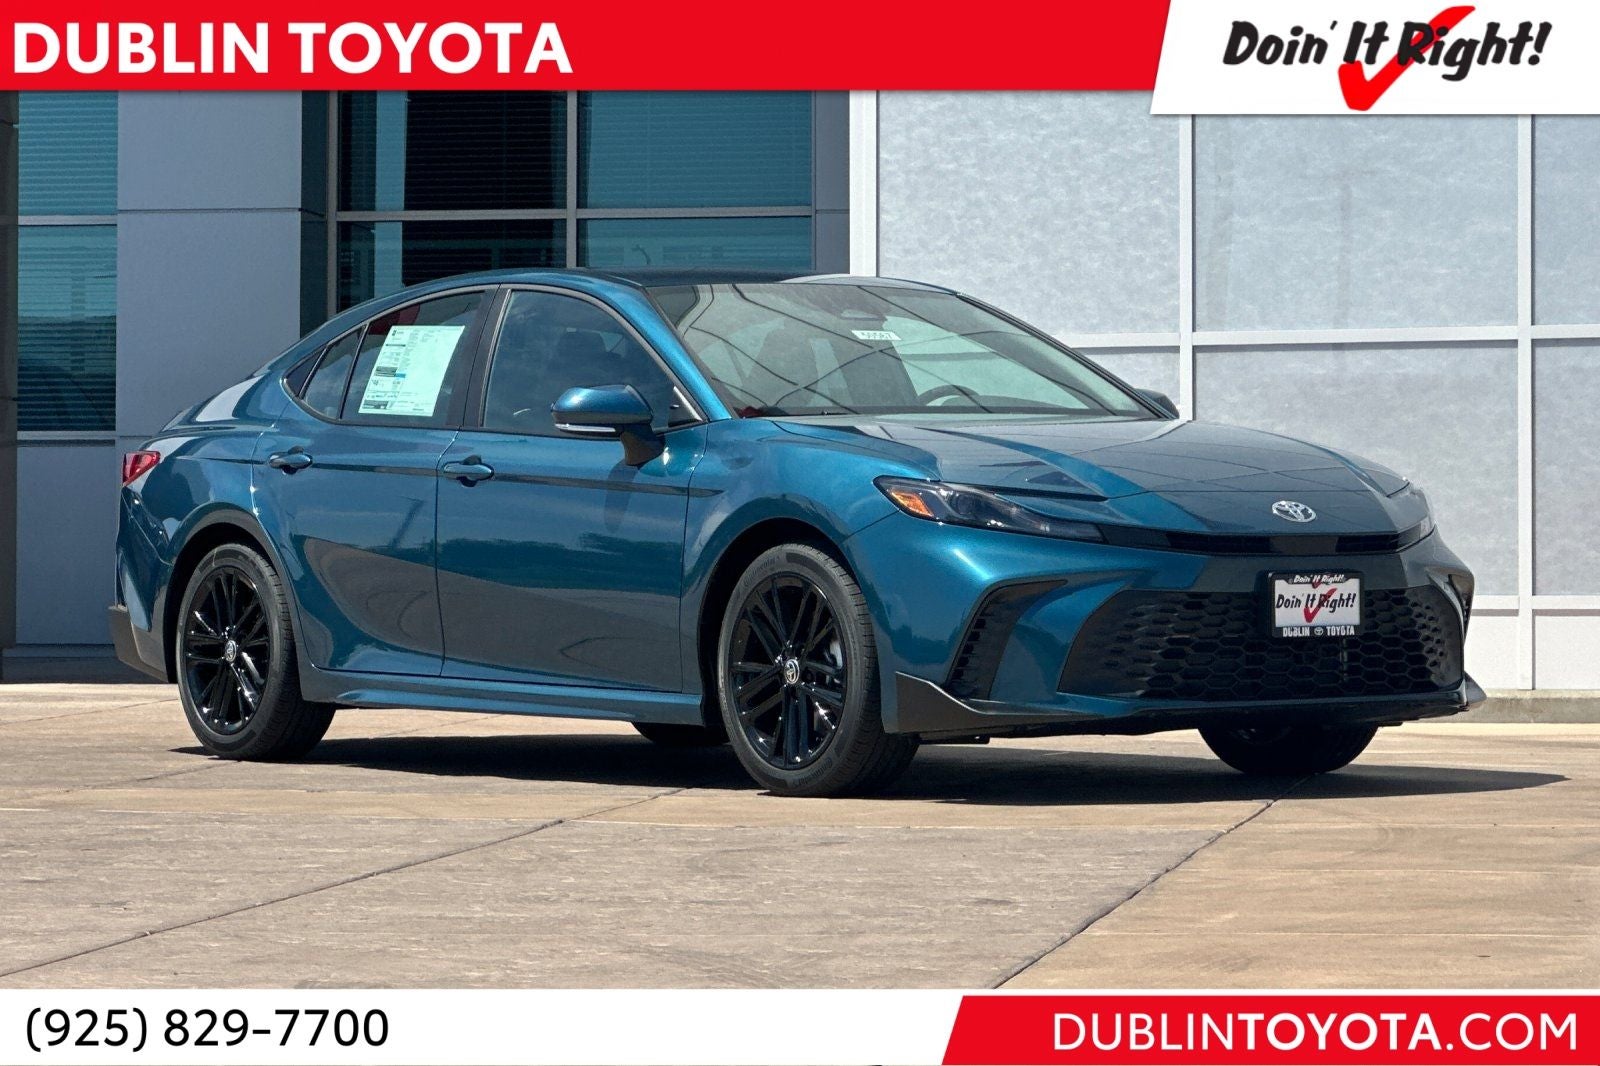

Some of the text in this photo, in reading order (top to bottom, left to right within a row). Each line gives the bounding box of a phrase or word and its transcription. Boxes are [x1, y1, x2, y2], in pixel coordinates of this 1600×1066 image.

[1312, 574, 1321, 583] It
[1321, 574, 1344, 585] Right!
[1275, 593, 1357, 613] Doin' It Right!
[1282, 625, 1355, 638] DUBLIN TOYOTA
